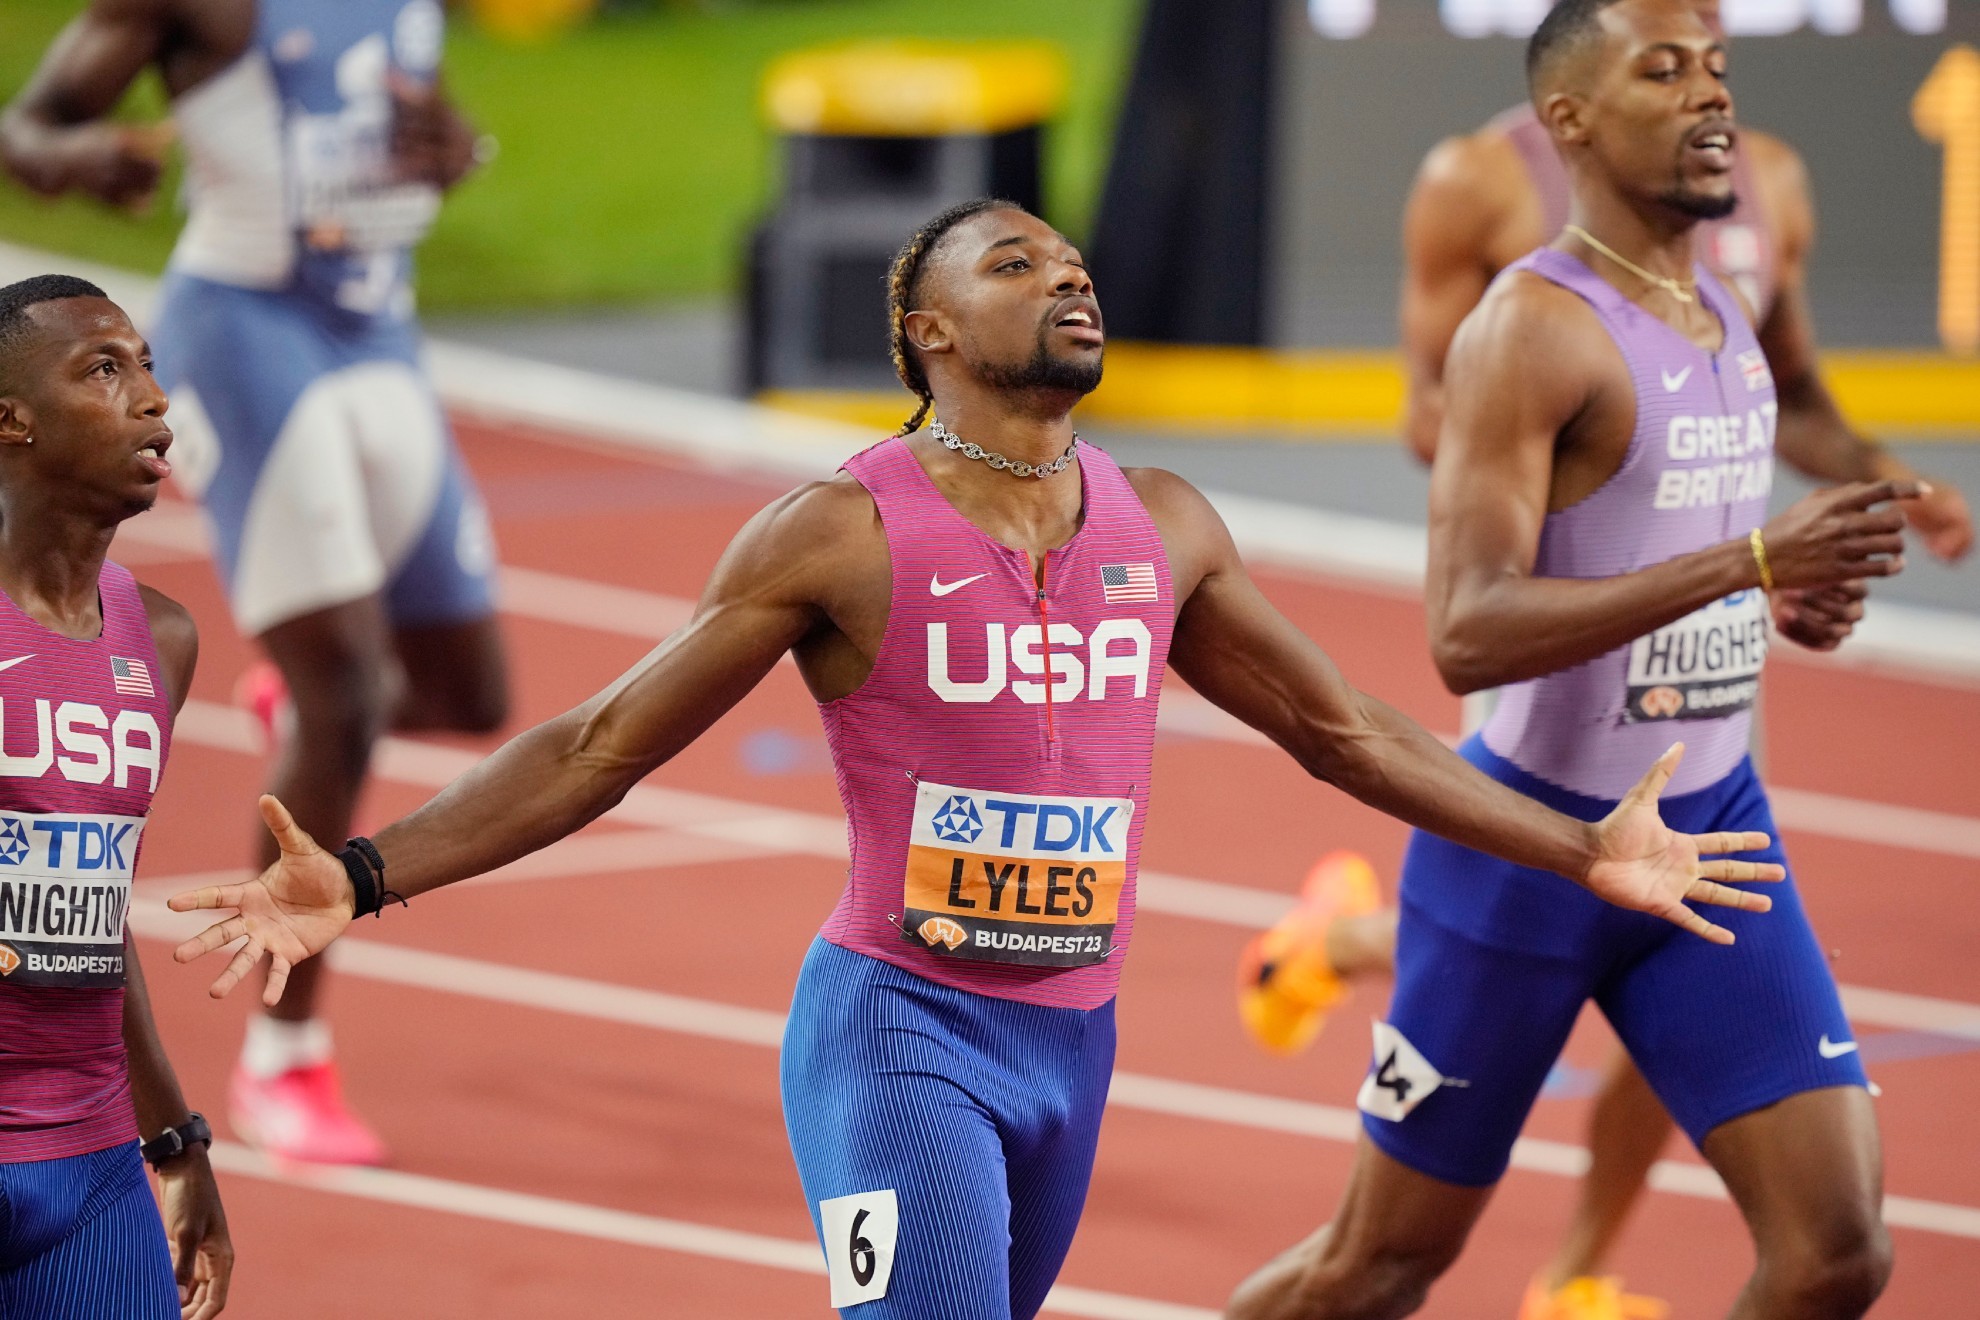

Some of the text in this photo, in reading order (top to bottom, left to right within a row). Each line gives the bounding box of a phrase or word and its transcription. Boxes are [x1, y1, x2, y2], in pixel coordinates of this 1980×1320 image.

[1667, 401, 1778, 461] GREAT
[927, 618, 1152, 704] USA
[0, 696, 161, 793] USA
[32, 820, 135, 870] TDK
[985, 799, 1118, 853] TDK
[948, 857, 1097, 918] LYLES
[974, 929, 1102, 954] BUDAPEST23
[1376, 1048, 1412, 1103] 4
[849, 1208, 876, 1287] 6
